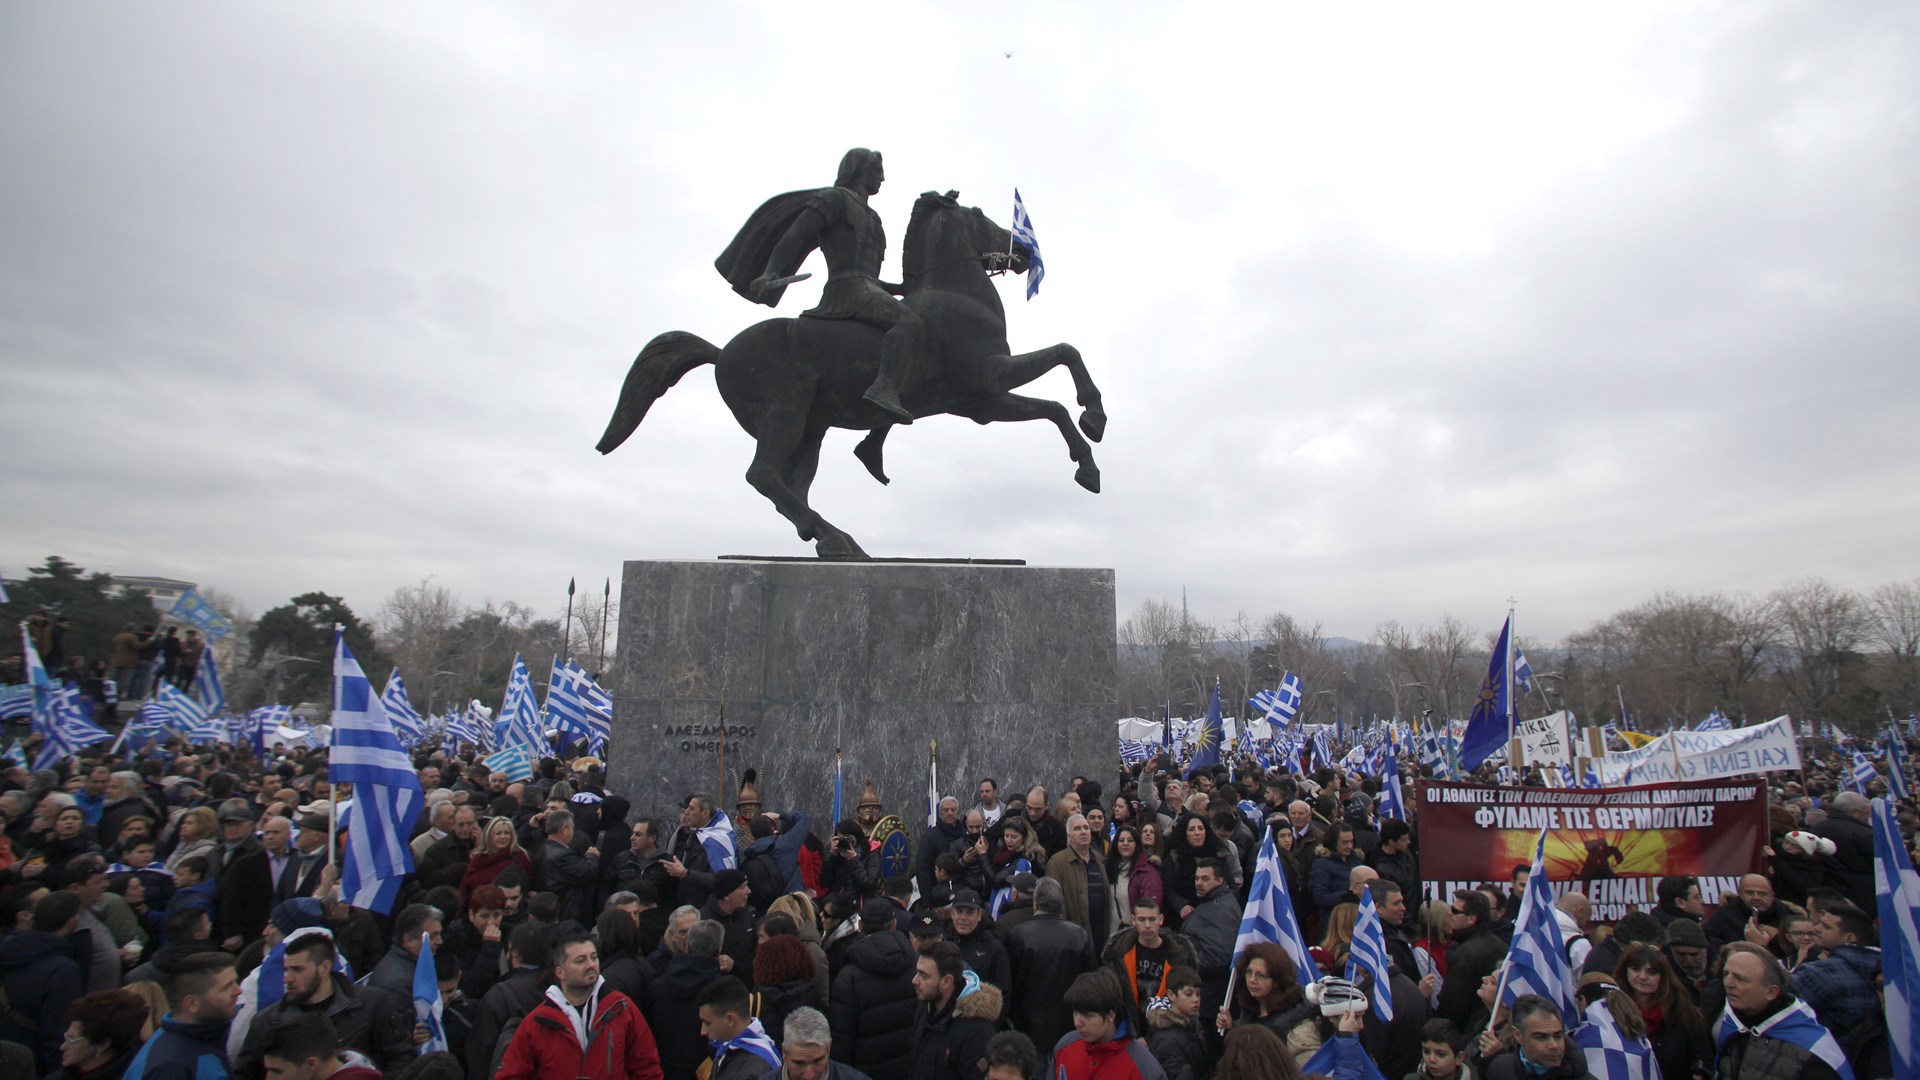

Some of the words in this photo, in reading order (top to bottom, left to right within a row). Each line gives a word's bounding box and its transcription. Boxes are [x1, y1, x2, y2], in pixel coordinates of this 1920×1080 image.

[681, 741, 691, 753] Ο
[1426, 787, 1440, 803] ΟΙ
[1442, 788, 1495, 803] ΑΘΛΗΤΕΣ
[1498, 789, 1524, 803] ΤΩΝ
[1525, 791, 1602, 804] ΠΟΛΕΜΙΚΩΝ
[1603, 790, 1649, 804] ΤΕΧΝΩΝ
[1652, 788, 1714, 803] ΔΗΛΩΝΟΥΝ
[1715, 787, 1757, 802] ΠΑΡΩΝ!
[1475, 806, 1560, 829] ΦΥΛΑΜΕ
[1561, 807, 1593, 829] ΤΙΣ
[1595, 806, 1715, 829] ΘΕΡΜΟΠΥΛΕΣ
[1588, 877, 1647, 904] ΕΙΝΑΙ
[1591, 904, 1627, 921] ΑΡΟΝ
